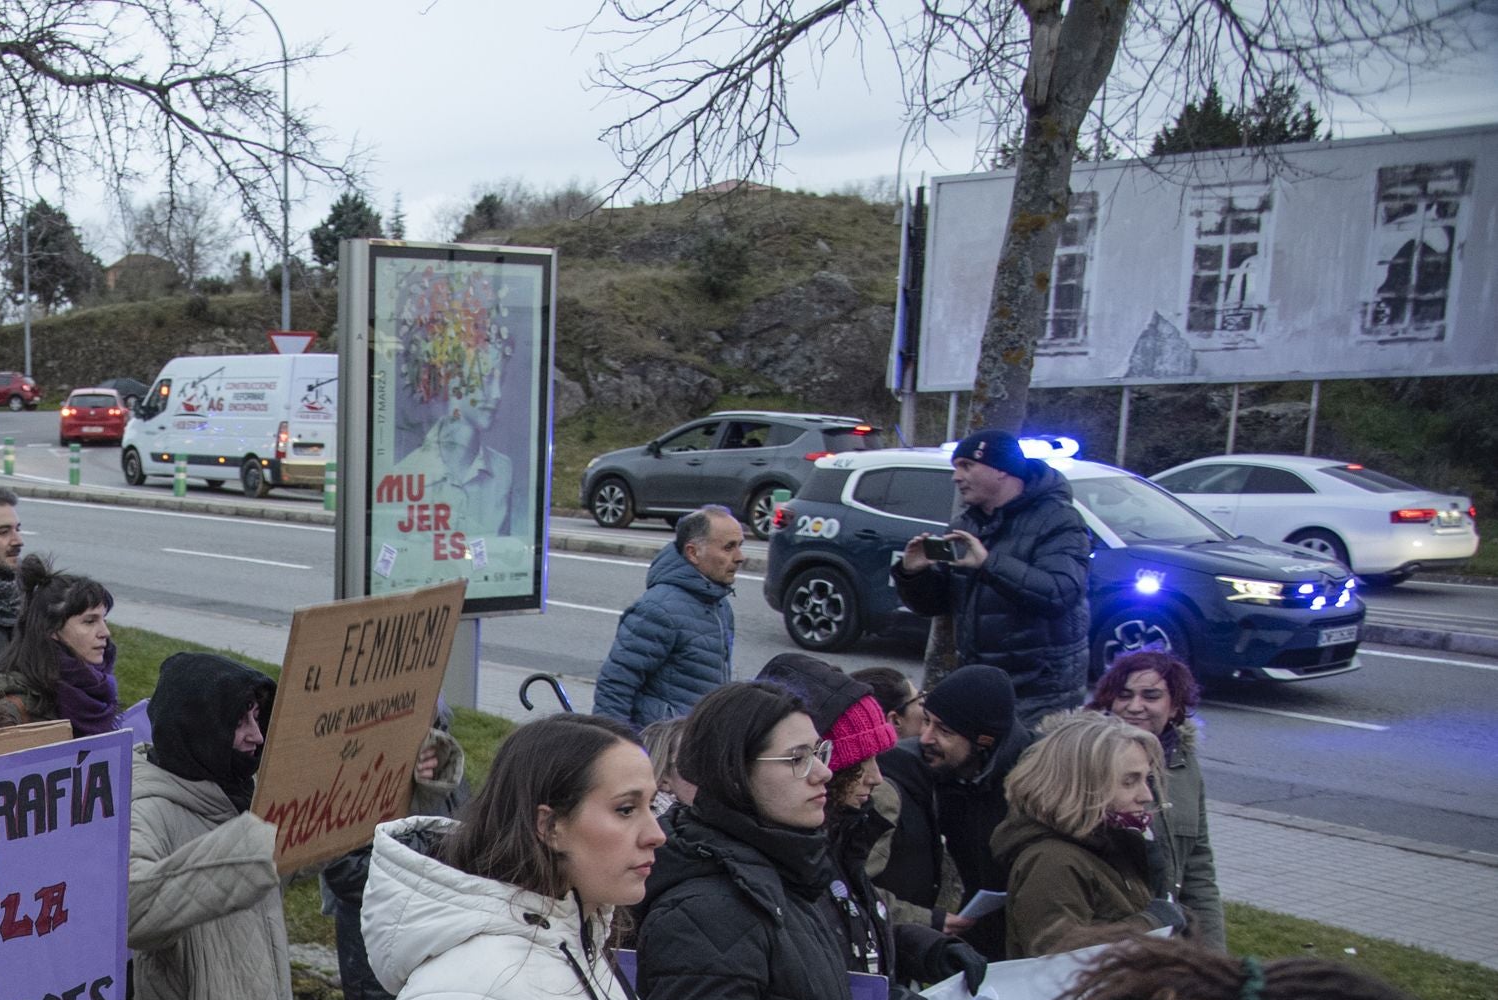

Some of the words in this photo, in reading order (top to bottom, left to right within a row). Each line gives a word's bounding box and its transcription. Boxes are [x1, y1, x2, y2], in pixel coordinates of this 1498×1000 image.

[376, 474, 424, 503] MU
[397, 503, 451, 532] JER
[433, 532, 466, 561] ES
[304, 665, 320, 692] EL
[336, 604, 450, 688] FEMINISMO
[314, 709, 343, 738] QUE
[346, 703, 364, 727] NO
[365, 689, 417, 722] INCOMODA
